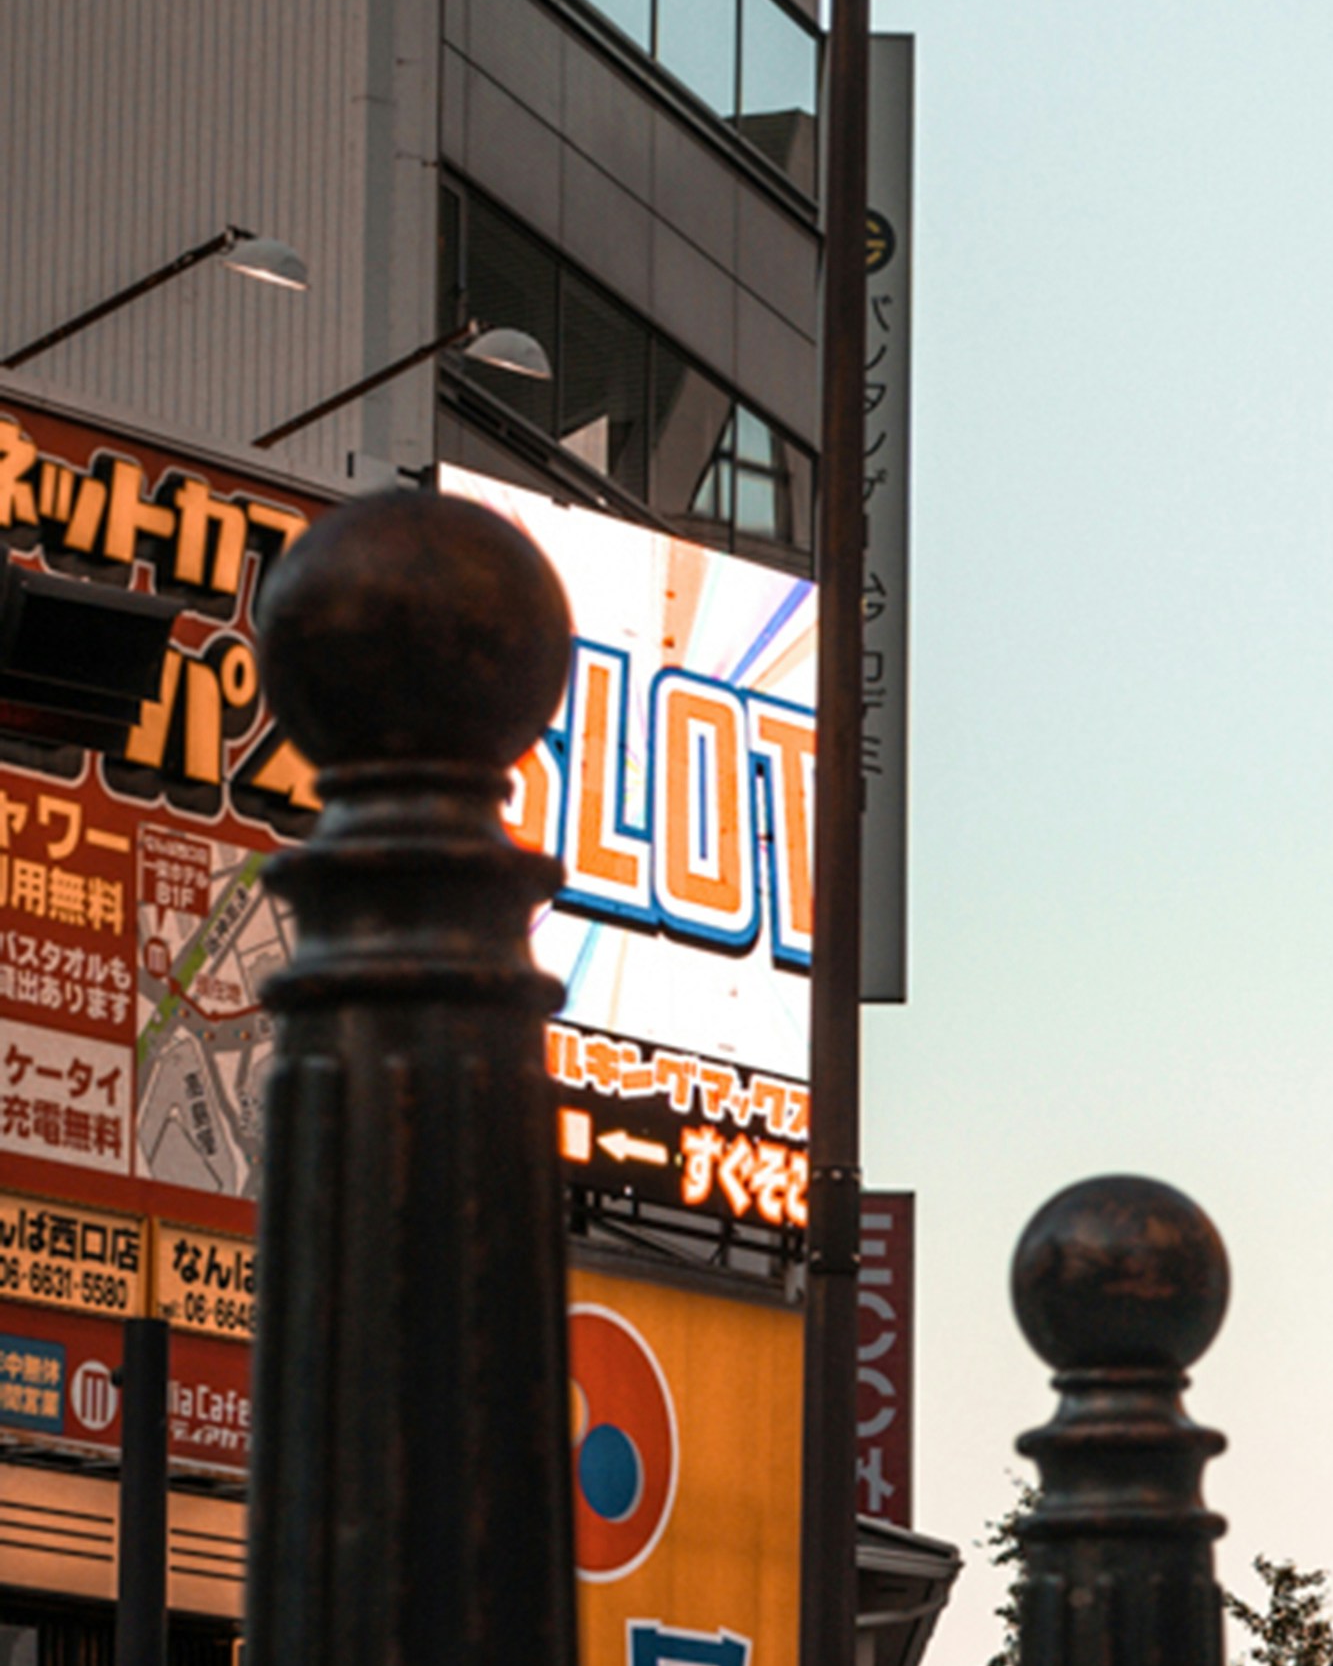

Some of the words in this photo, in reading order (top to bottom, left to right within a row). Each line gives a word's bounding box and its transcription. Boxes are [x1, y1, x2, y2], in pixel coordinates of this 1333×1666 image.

[4, 1044, 122, 1106] ケータイ
[1, 1094, 123, 1160] 充電無料
